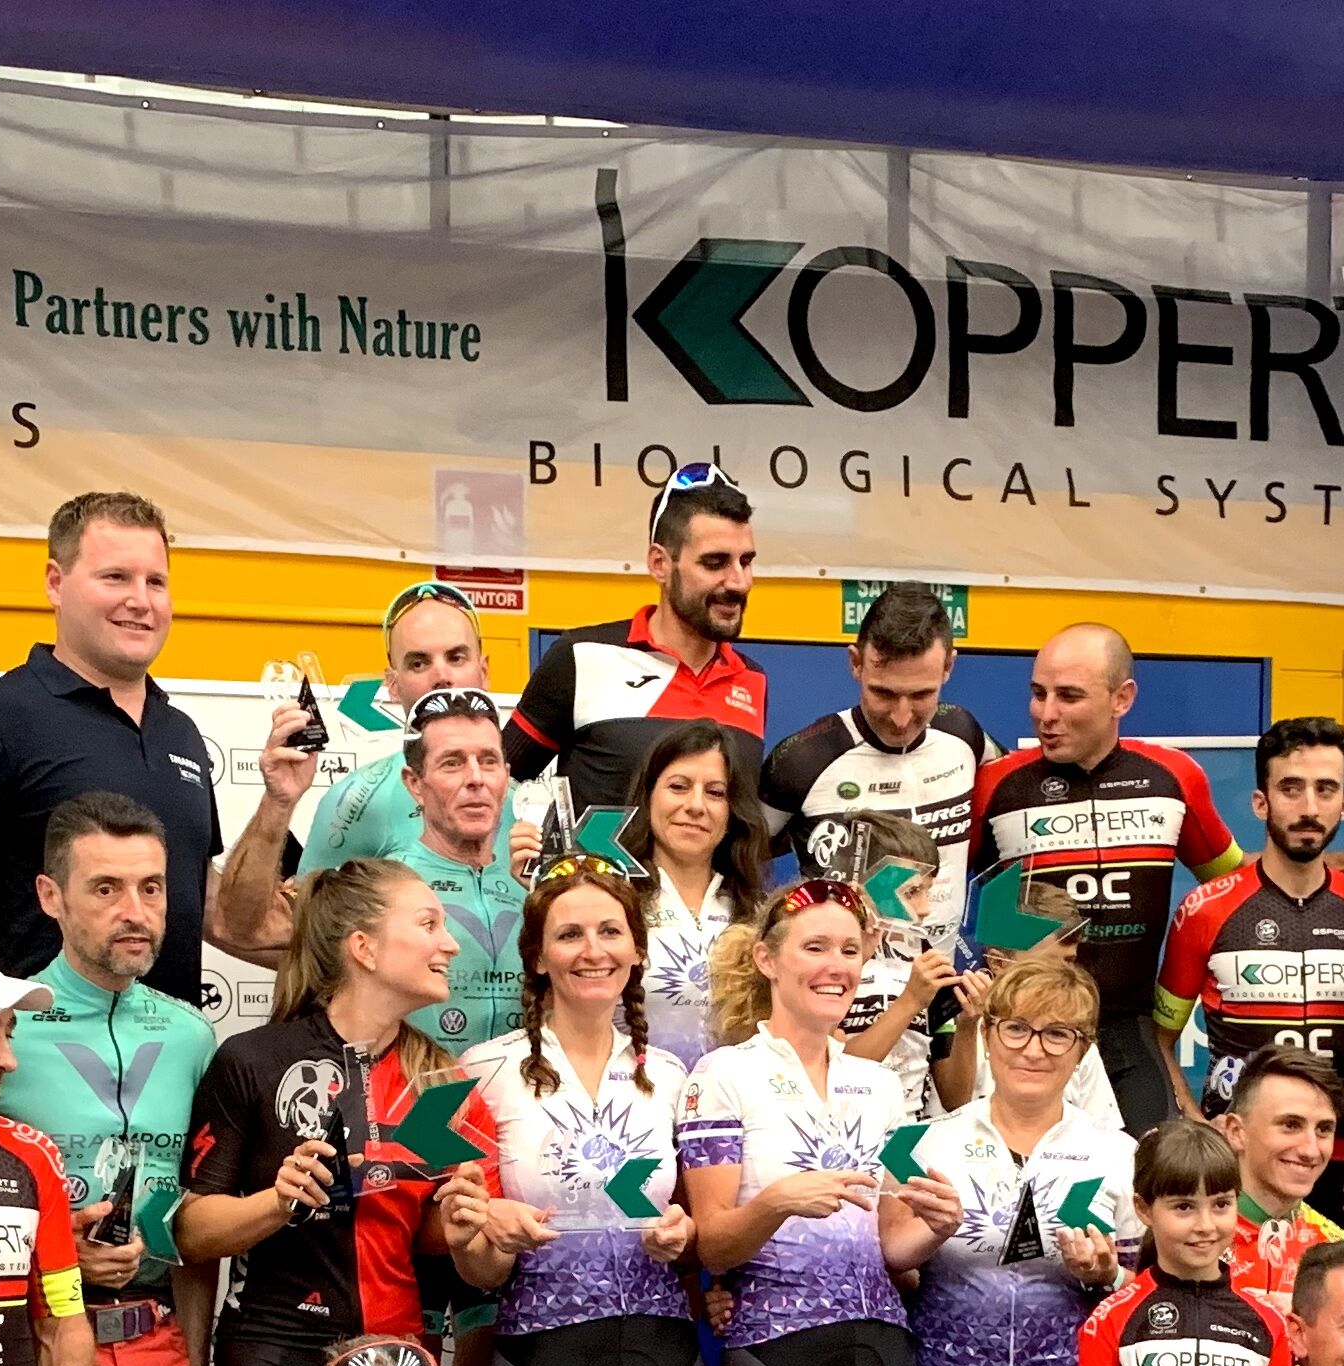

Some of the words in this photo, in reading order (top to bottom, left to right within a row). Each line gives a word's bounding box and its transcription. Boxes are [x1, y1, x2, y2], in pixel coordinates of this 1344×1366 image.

[13, 269, 209, 346] Partners
[227, 293, 322, 354] with
[338, 290, 480, 363] Nature
[529, 437, 1090, 509] BIOLOGICAL
[467, 591, 518, 607] TINTOR
[931, 819, 972, 839] HOP
[1024, 809, 1150, 839] KOPPERT
[1108, 833, 1163, 844] SYSTEMS
[1066, 871, 1132, 901] OC
[1084, 920, 1148, 938] ÉSPEDES
[244, 993, 270, 1004] BICI
[1230, 990, 1305, 1000] BIOLOGICAL
[770, 1077, 803, 1095] SGR
[965, 1143, 998, 1158] SGR
